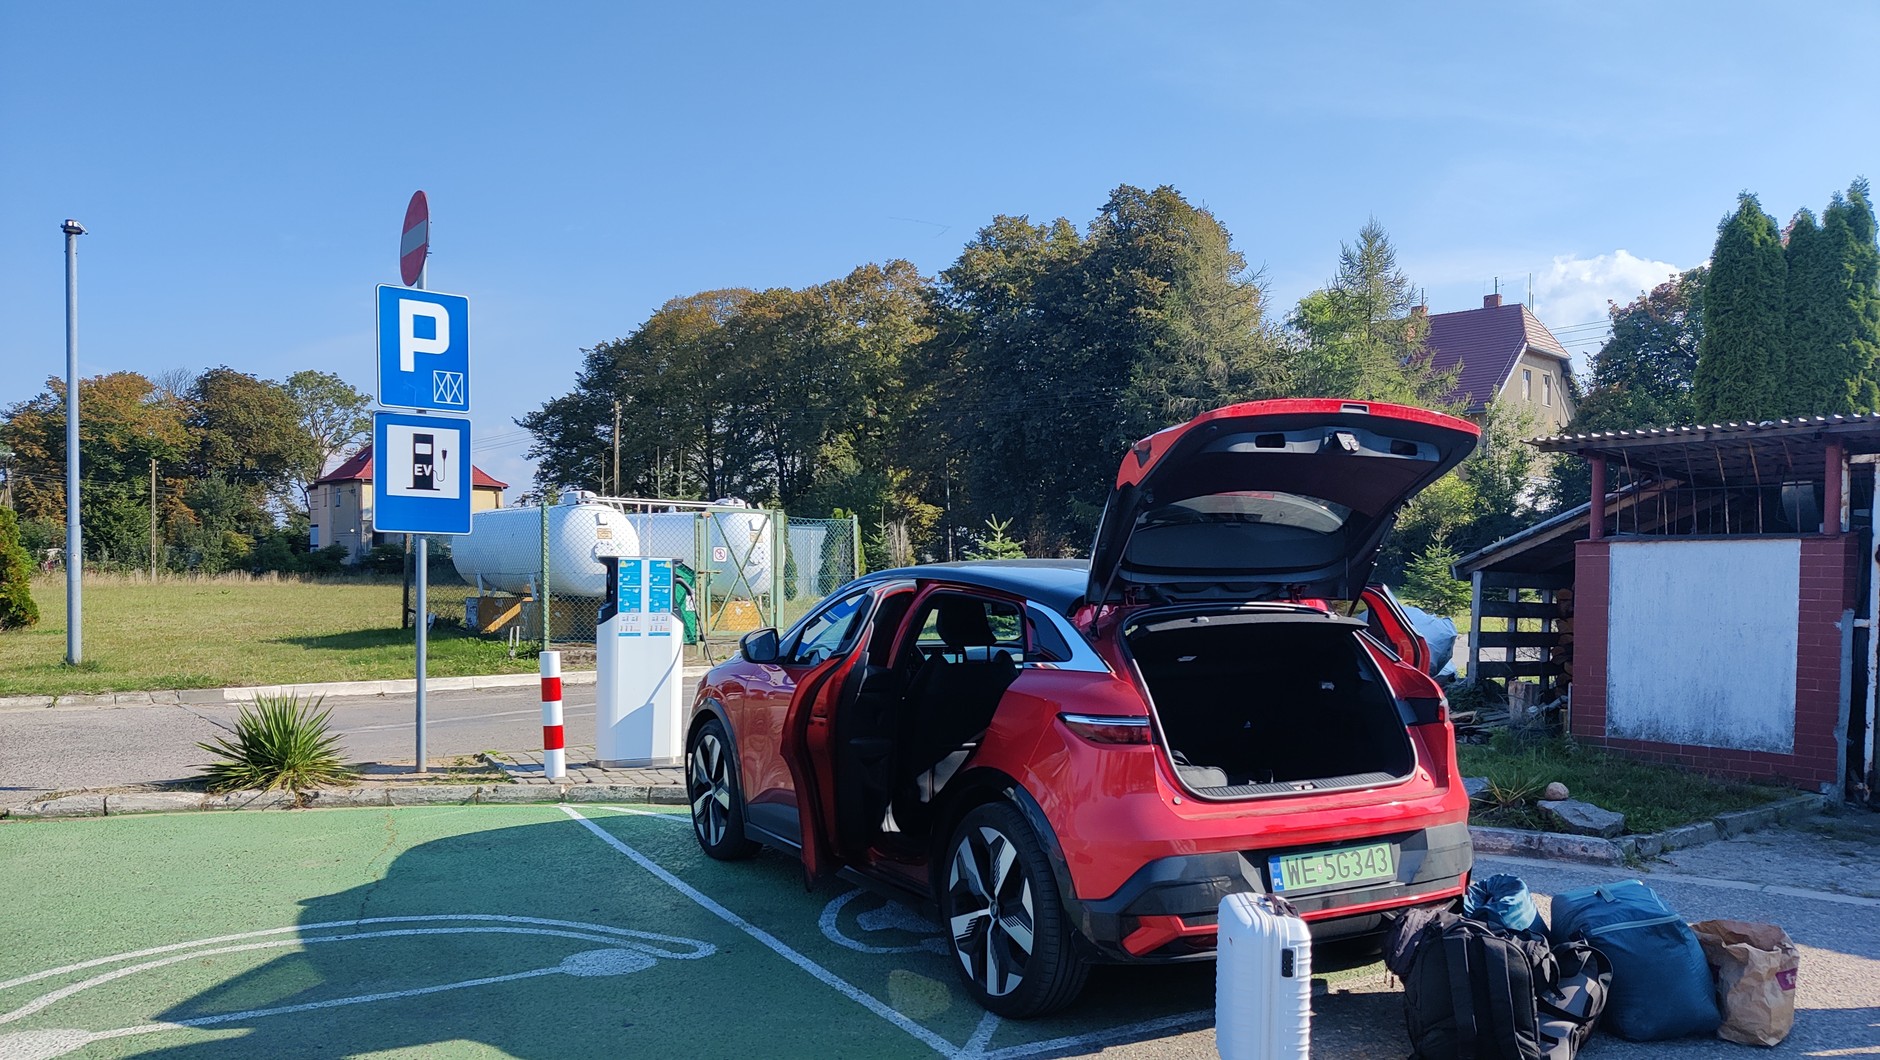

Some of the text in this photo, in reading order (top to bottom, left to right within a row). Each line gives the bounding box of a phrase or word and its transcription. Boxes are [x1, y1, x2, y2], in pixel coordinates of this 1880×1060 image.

[399, 298, 450, 372] P
[414, 463, 432, 476] EV
[1286, 847, 1388, 886] WE 5G343
[1274, 878, 1283, 886] PL
